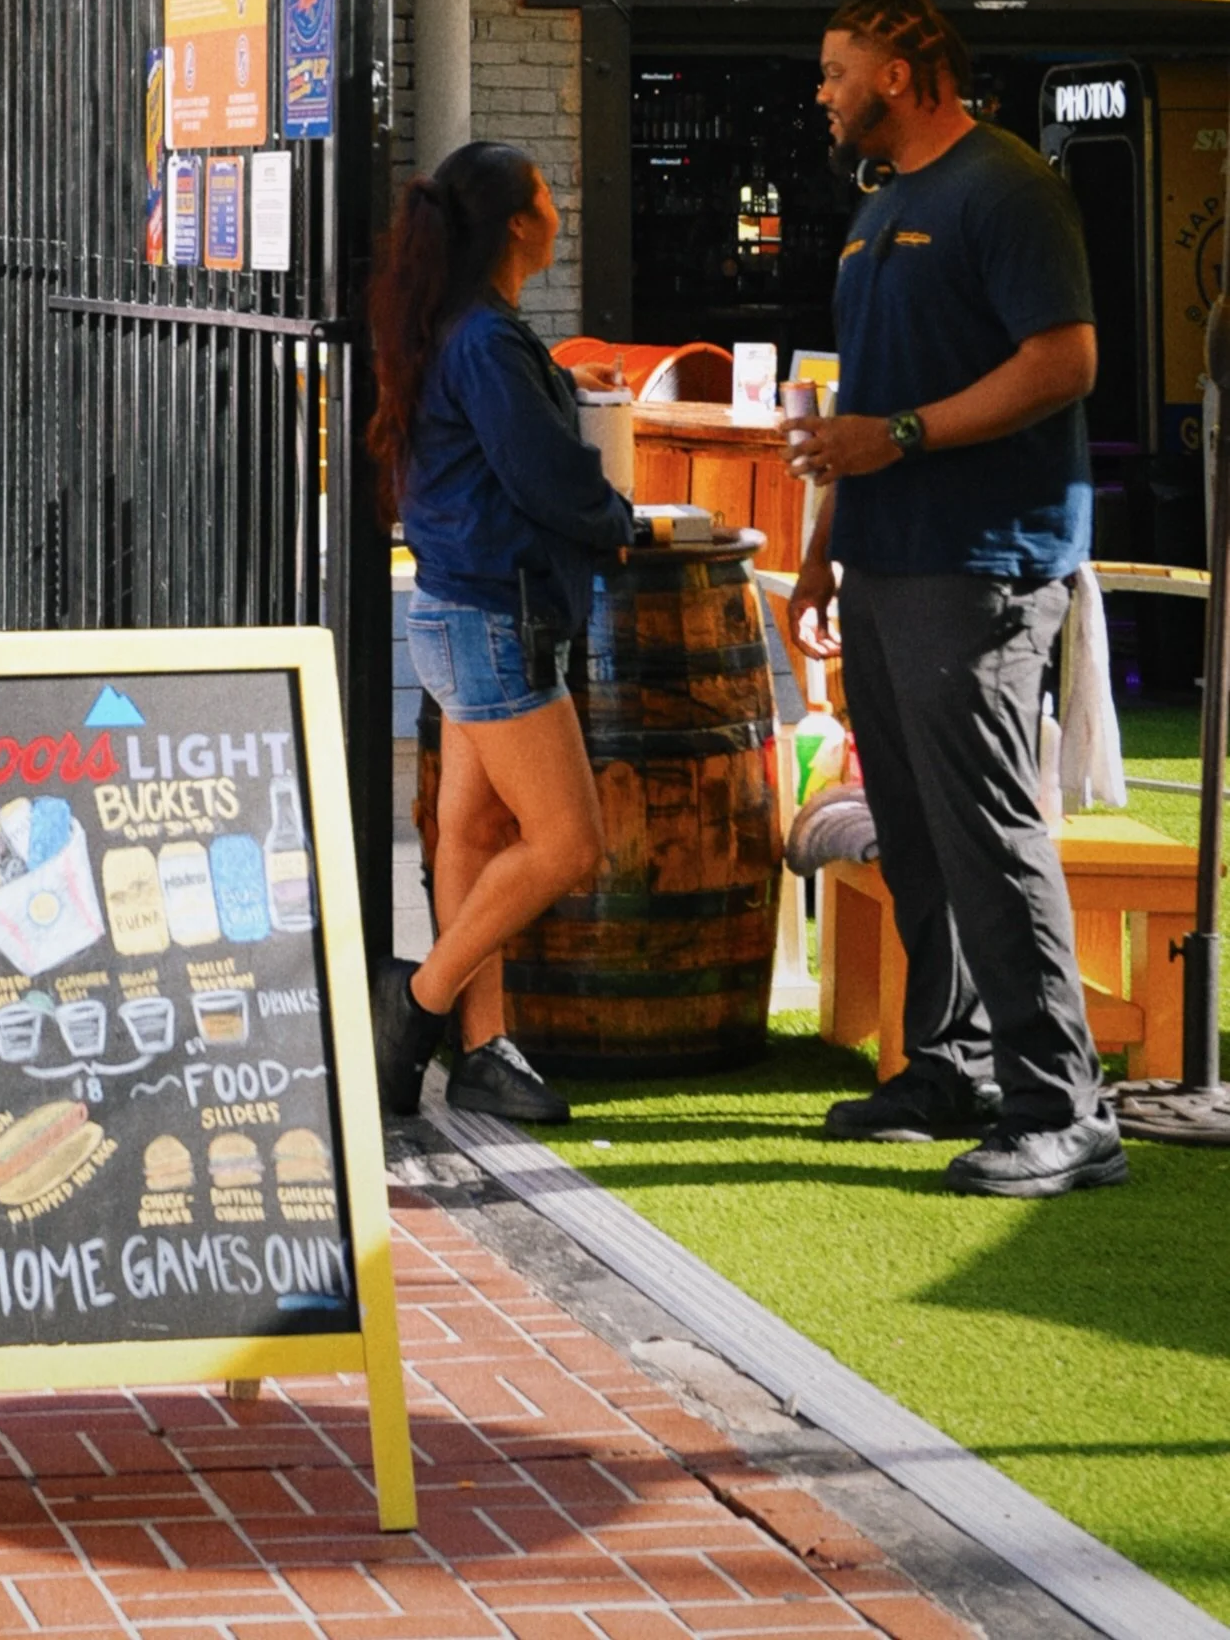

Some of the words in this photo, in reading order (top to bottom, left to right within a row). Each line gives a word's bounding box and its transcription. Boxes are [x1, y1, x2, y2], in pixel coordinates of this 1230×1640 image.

[1055, 79, 1125, 122] PHOTOS
[126, 732, 290, 780] LIGHT
[93, 777, 240, 832] BUCKETS
[257, 988, 320, 1018] DRINKS
[184, 1060, 290, 1108] FOOD
[201, 1102, 281, 1129] SLIDERS
[121, 1231, 263, 1300] GAMES
